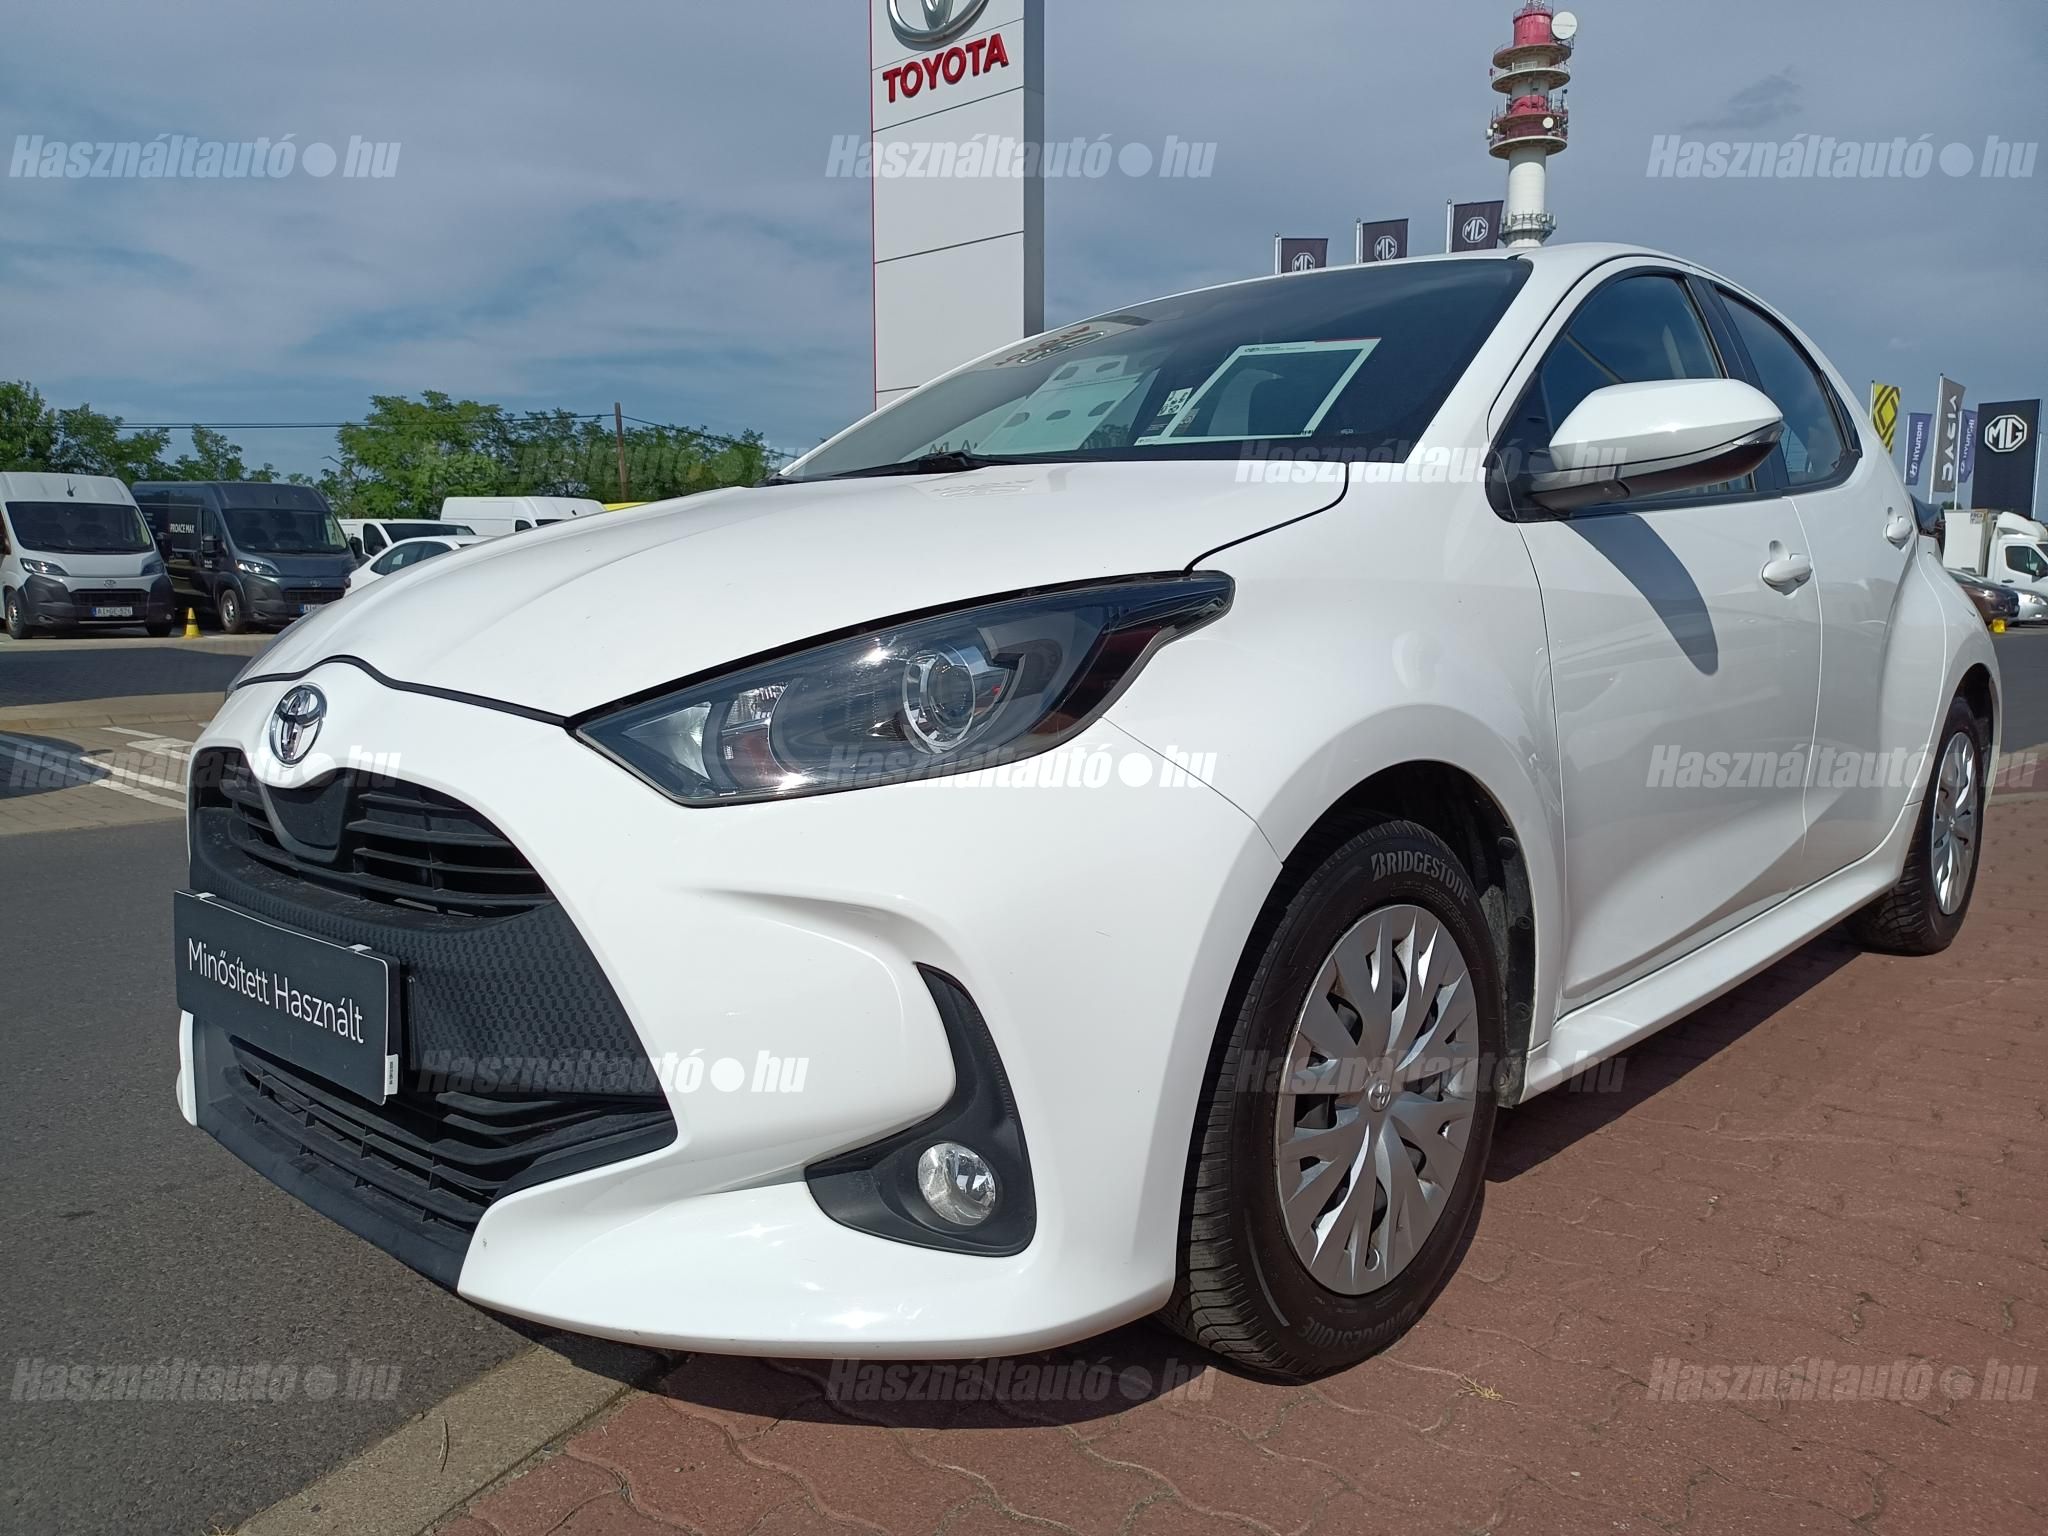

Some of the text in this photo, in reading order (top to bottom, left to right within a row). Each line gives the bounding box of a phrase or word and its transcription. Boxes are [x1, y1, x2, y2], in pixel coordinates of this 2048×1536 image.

[883, 33, 1009, 103] TOYOTA
[1375, 236, 1396, 260] MG
[1463, 218, 1487, 241] MG
[1942, 395, 1957, 481] DACIA
[1987, 417, 2025, 450] MG
[170, 523, 195, 534] PROACE MAX
[1371, 850, 1469, 906] BRIDGESTONE
[188, 938, 364, 1044] Minősített Használt
